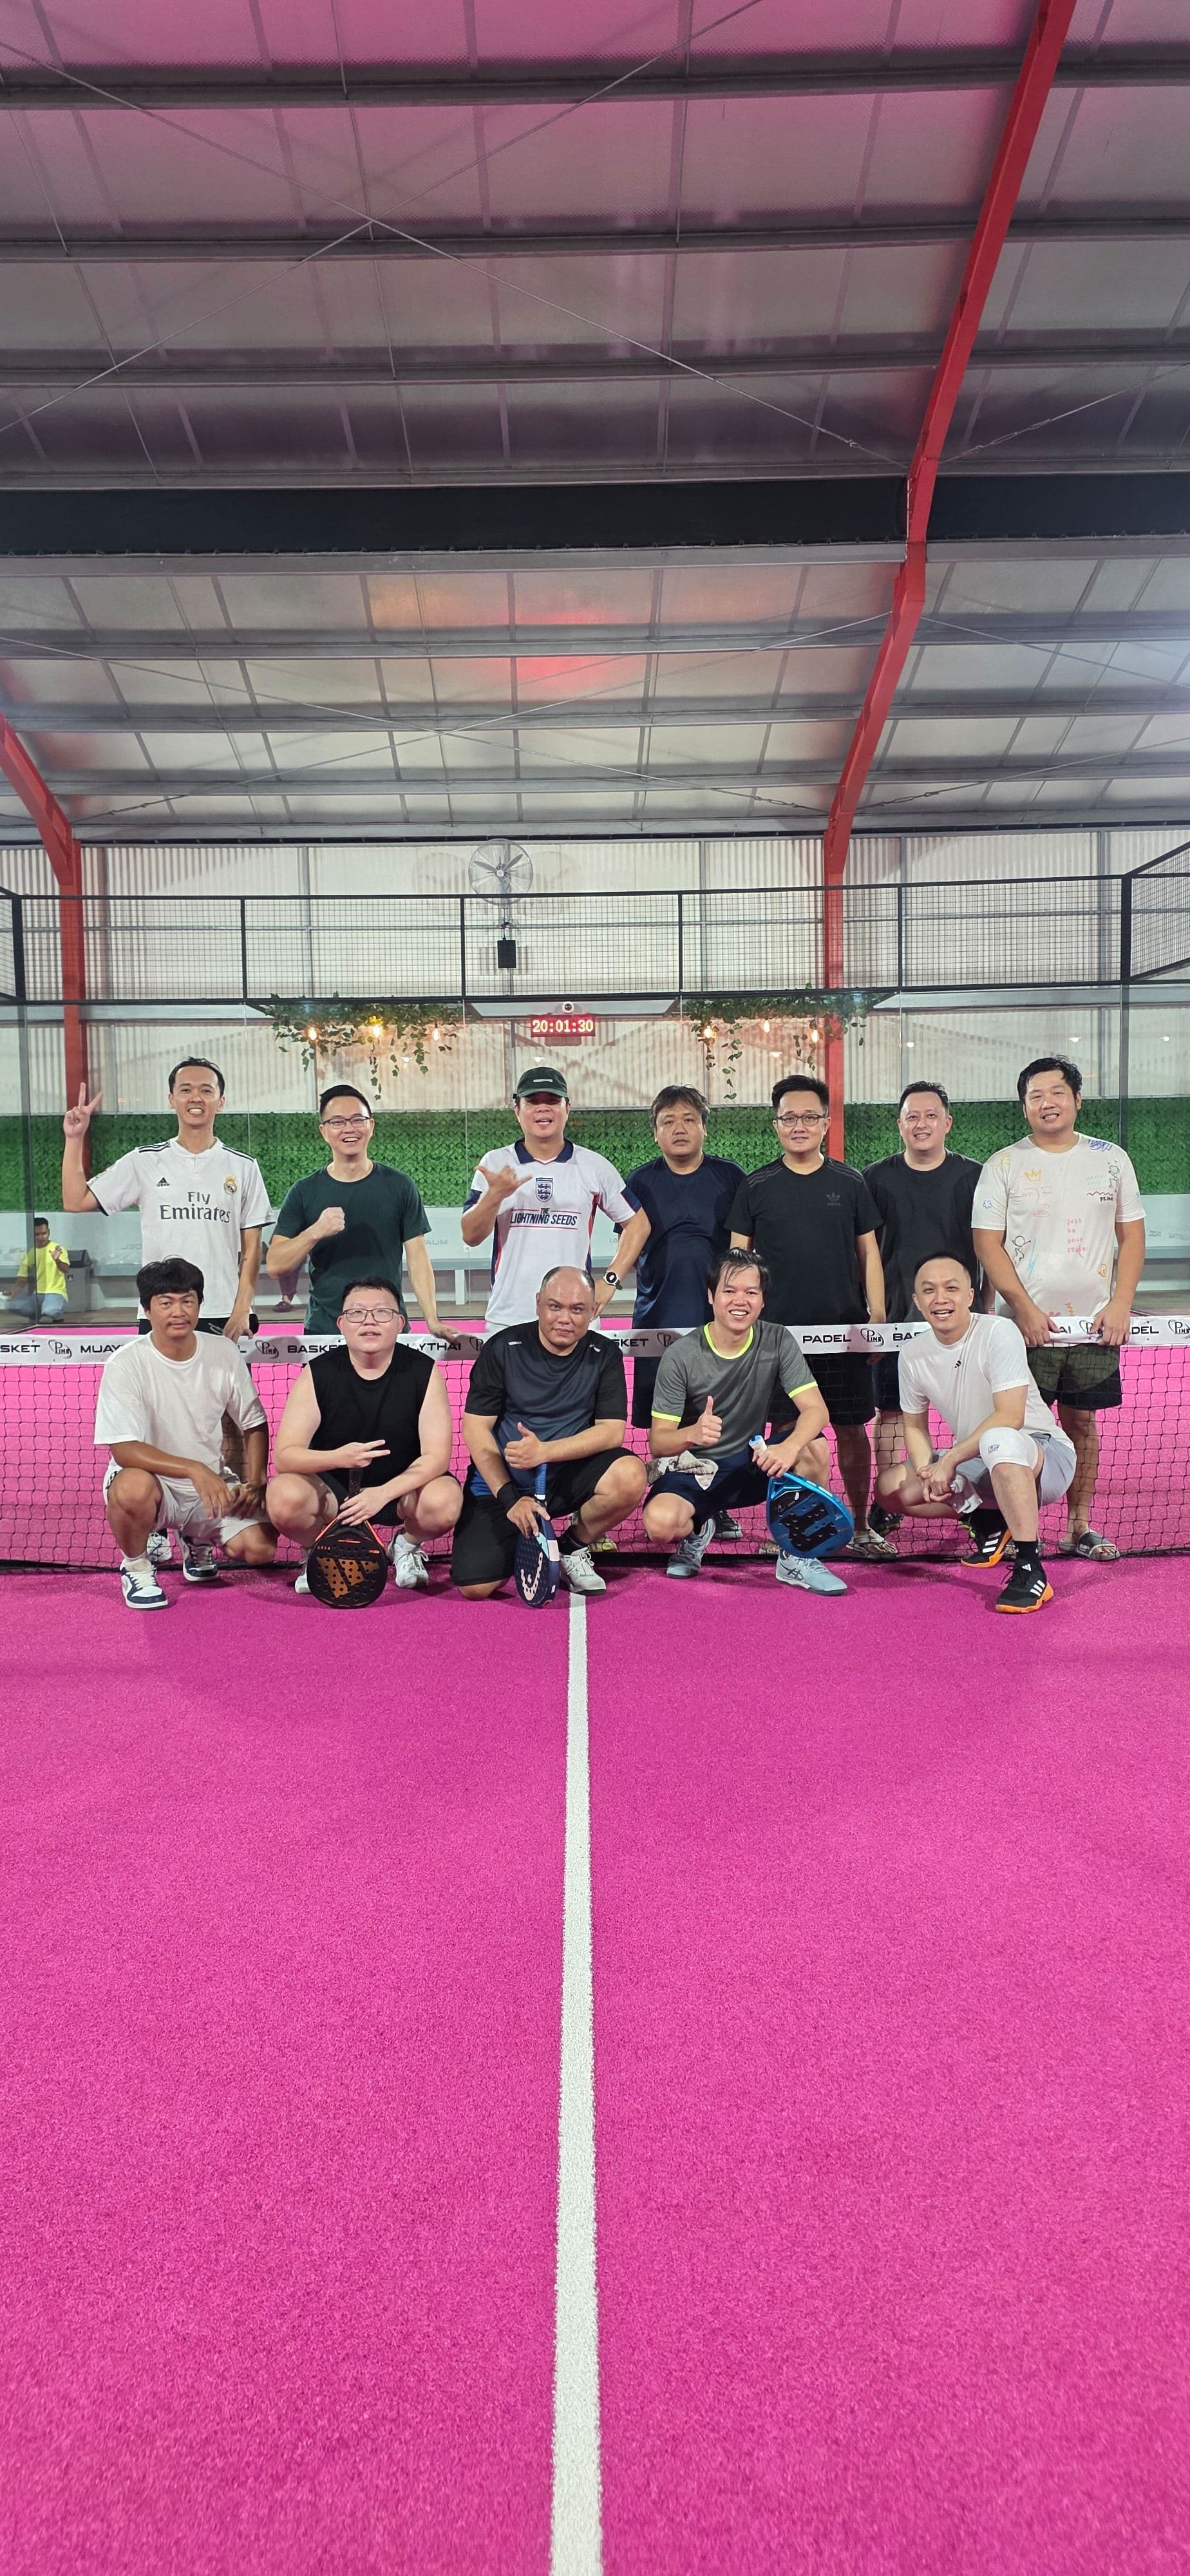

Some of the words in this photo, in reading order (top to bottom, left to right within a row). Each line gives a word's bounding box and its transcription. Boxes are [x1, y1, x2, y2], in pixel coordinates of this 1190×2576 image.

[533, 1019, 594, 1033] 20:01:30
[187, 1191, 211, 1205] Fly
[159, 1203, 231, 1224] Emirates
[510, 1213, 551, 1224] LIGHTNING
[551, 1214, 578, 1226] SEEDS
[0, 1345, 41, 1353] SKET
[80, 1345, 121, 1353] MUAY
[419, 1342, 461, 1351] YTHAI
[802, 1334, 852, 1344] PADEL
[1131, 1325, 1160, 1334] DEL
